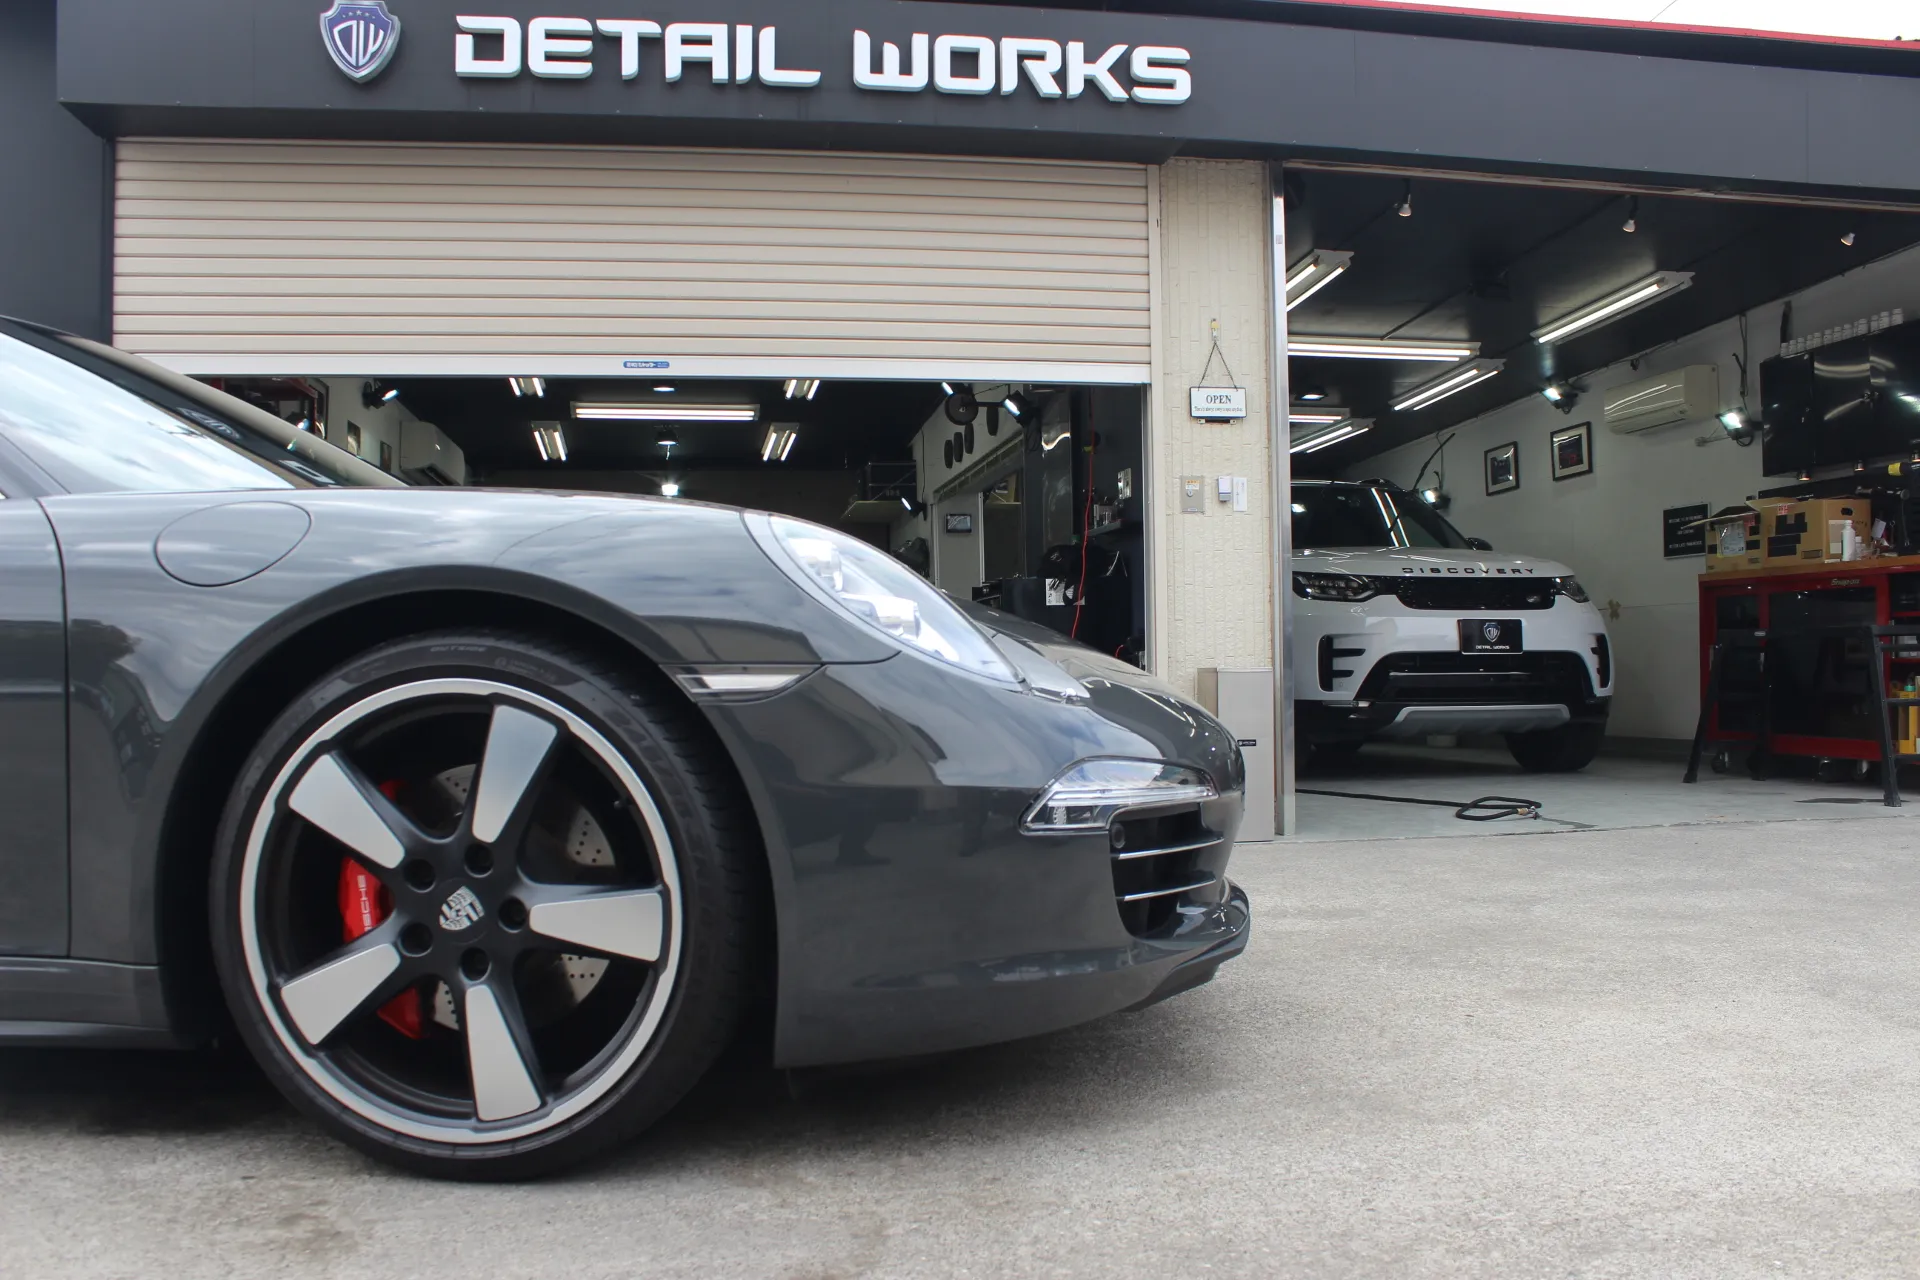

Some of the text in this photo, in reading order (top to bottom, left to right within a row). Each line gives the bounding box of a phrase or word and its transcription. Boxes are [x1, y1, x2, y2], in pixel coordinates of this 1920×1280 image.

[455, 15, 1192, 104] DETAIL WORKS
[1206, 395, 1232, 404] OPEN
